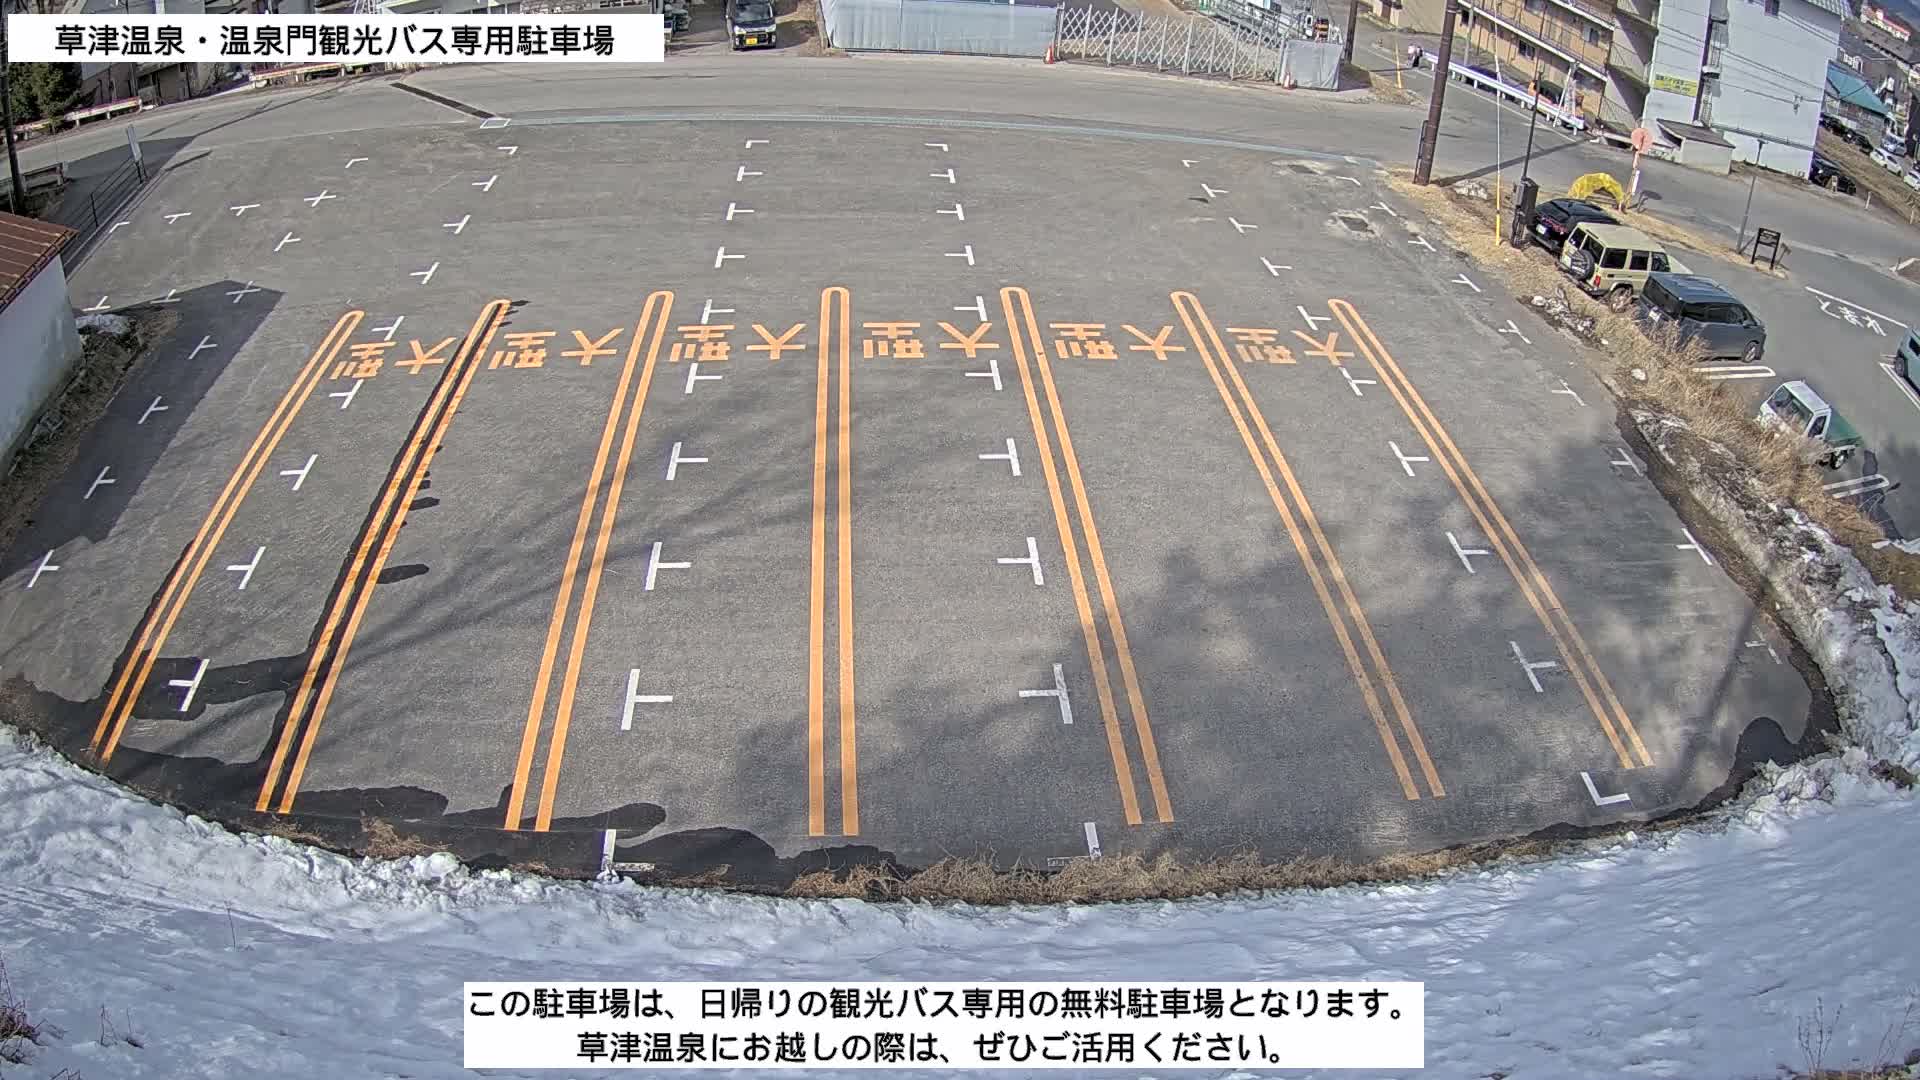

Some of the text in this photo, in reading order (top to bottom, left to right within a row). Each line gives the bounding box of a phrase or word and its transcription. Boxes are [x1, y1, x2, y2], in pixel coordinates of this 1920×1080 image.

[329, 337, 457, 380] 大型
[488, 328, 625, 370] 大型
[669, 323, 806, 361] 大型
[863, 322, 1000, 359] 大型
[1049, 323, 1186, 360] 大型
[1226, 327, 1354, 366] 大型
